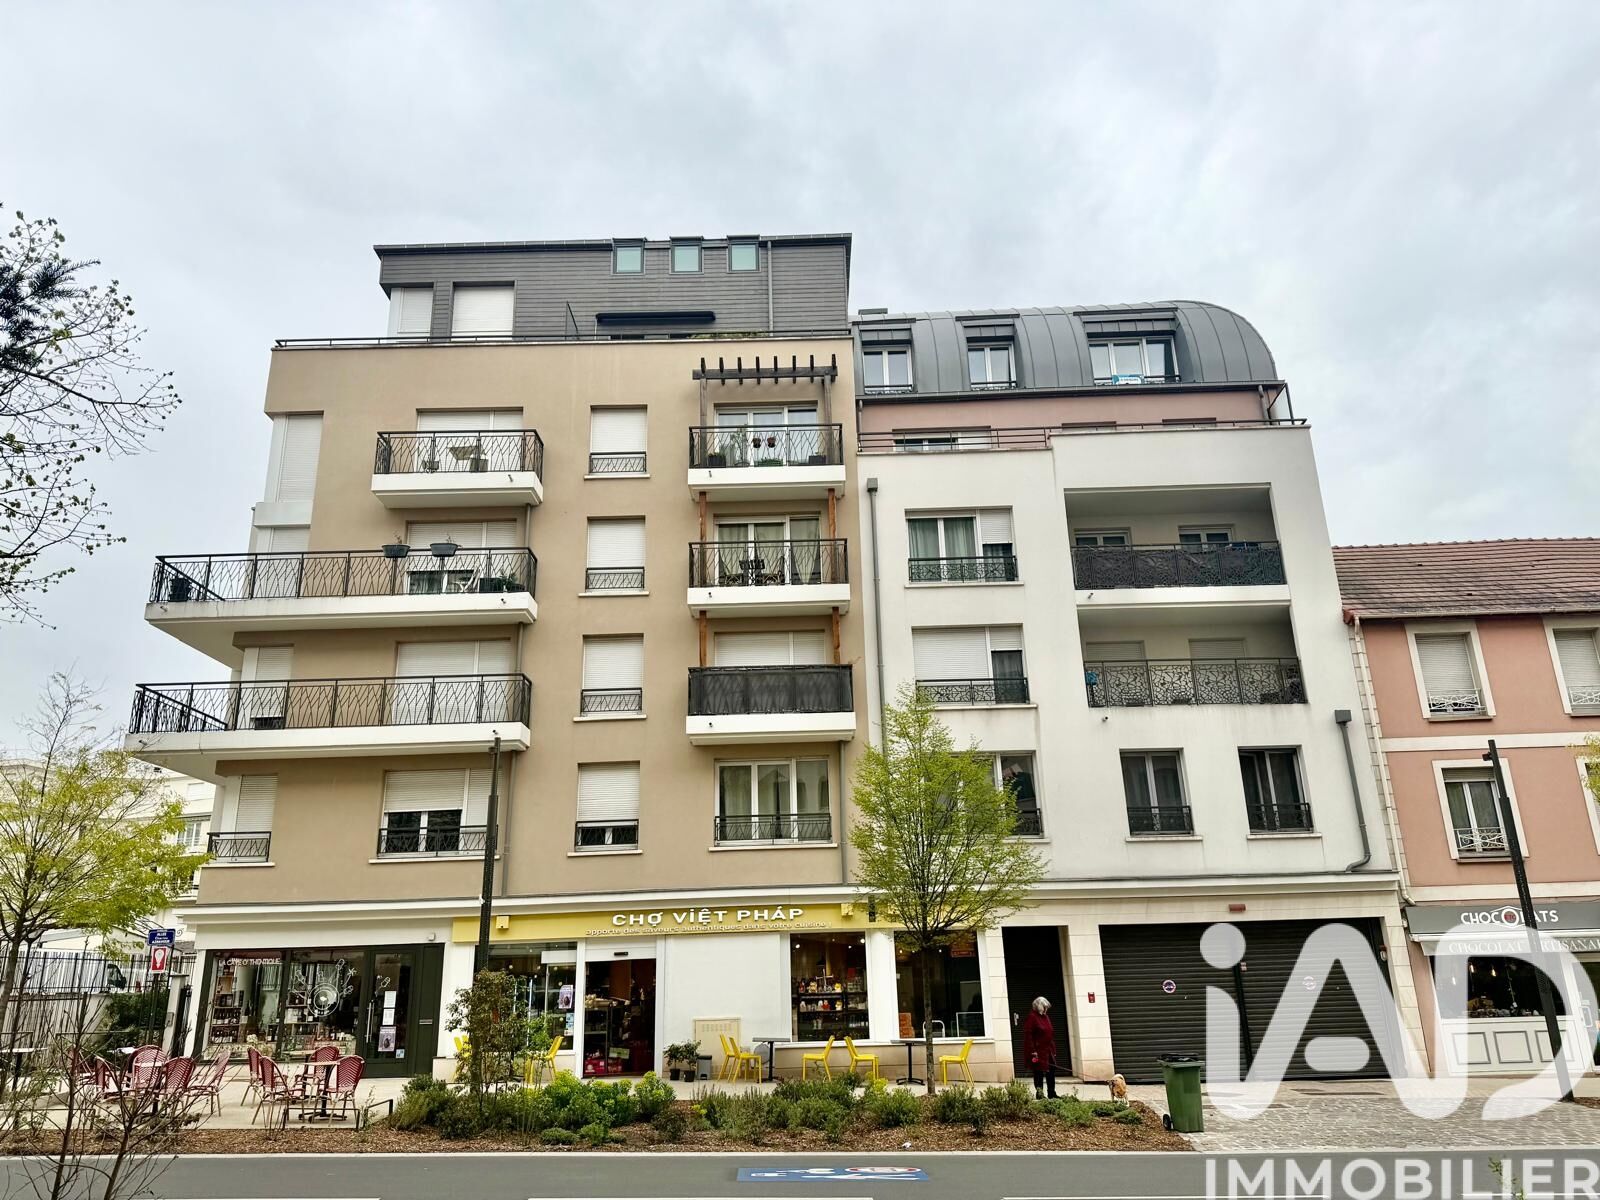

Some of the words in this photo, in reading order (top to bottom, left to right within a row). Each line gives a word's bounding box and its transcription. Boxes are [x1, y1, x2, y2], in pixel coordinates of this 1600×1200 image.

[737, 905, 804, 921] PHÁP
[585, 928, 621, 936] apporte
[623, 926, 640, 935] des
[642, 926, 678, 934] saveurs
[681, 924, 741, 933] authentiques
[743, 922, 766, 930] dans
[794, 920, 825, 928] cuisine
[1448, 940, 1522, 953] CHOCOLAT
